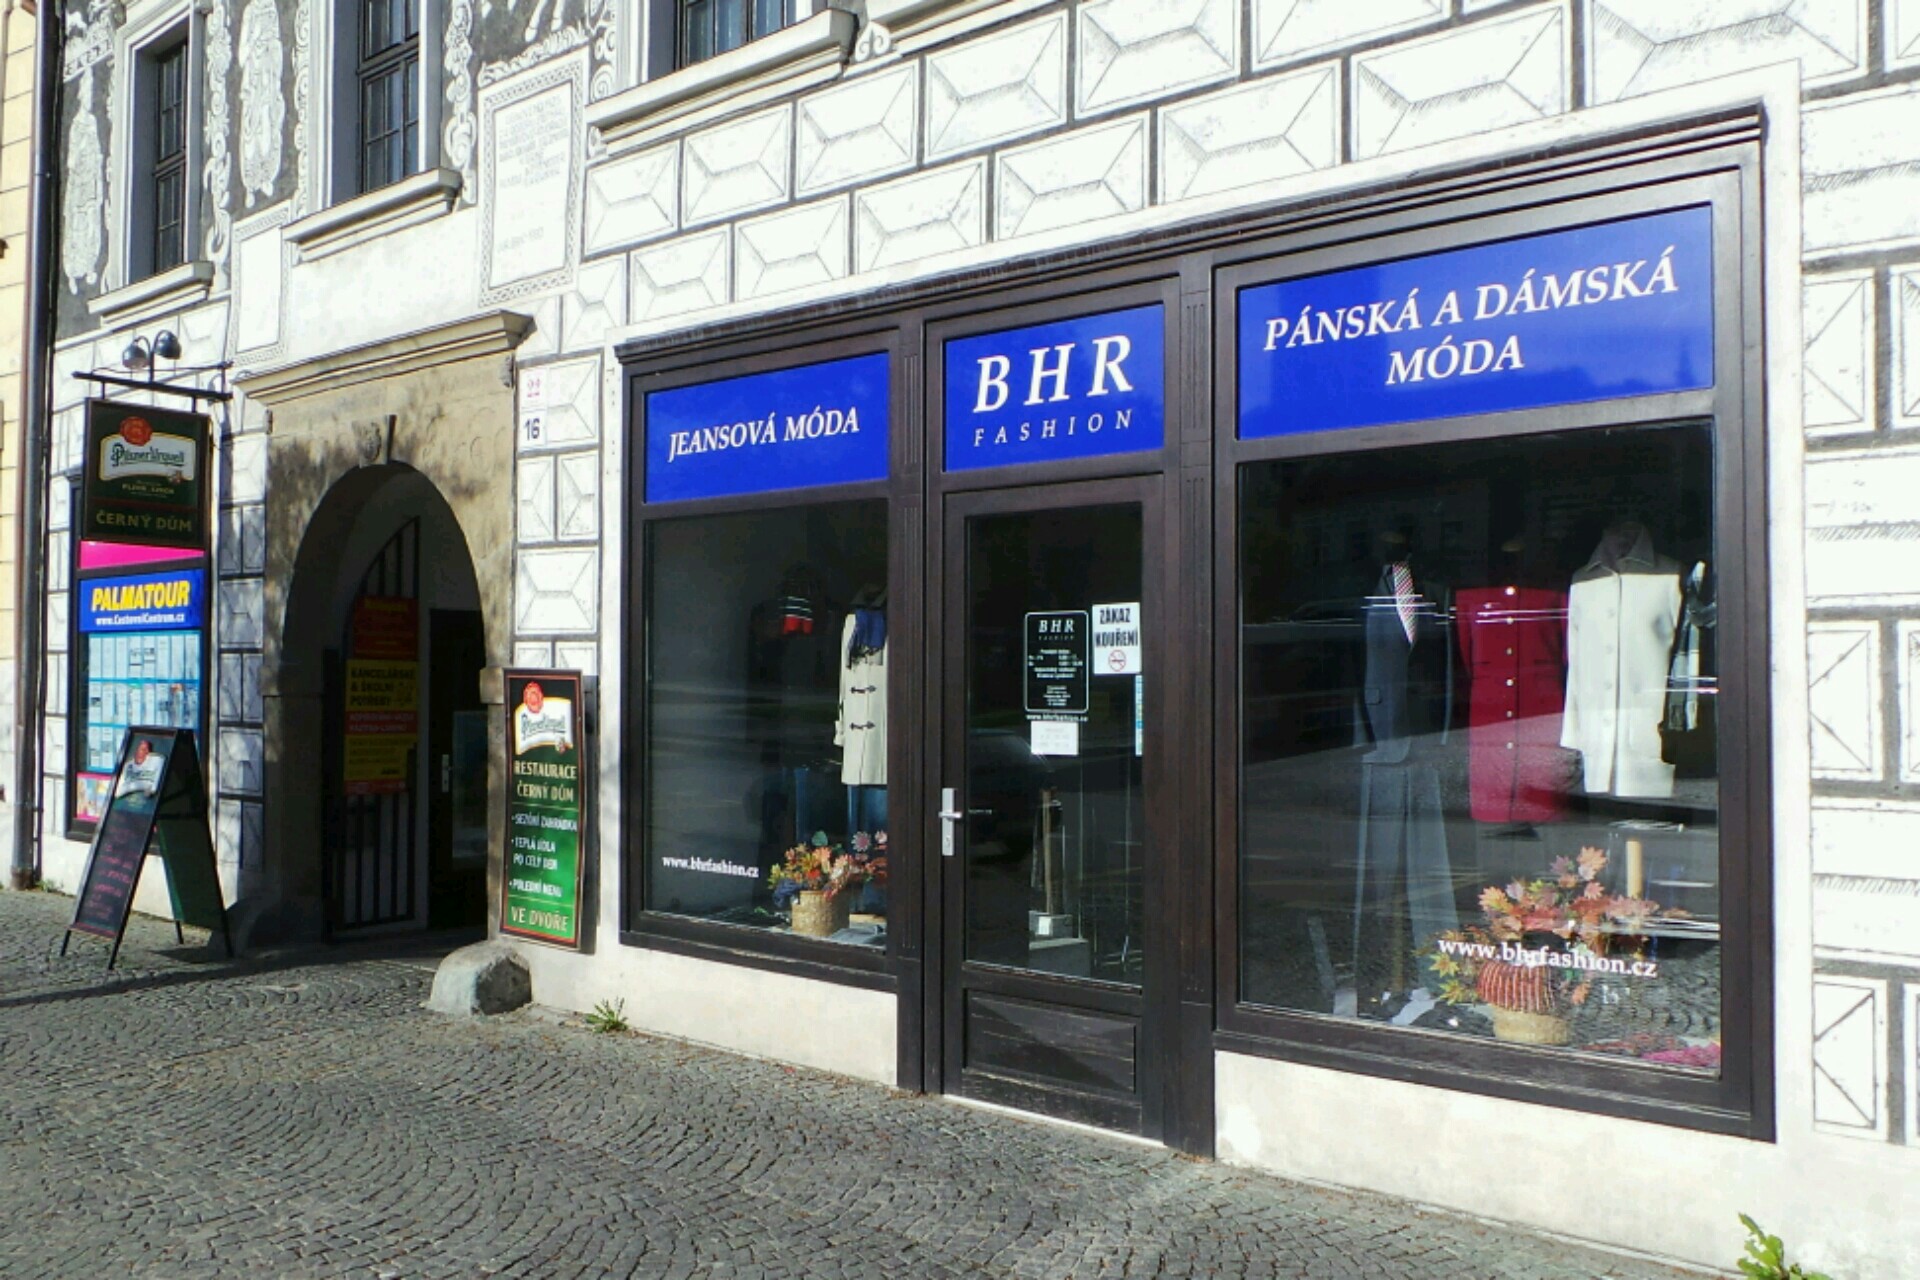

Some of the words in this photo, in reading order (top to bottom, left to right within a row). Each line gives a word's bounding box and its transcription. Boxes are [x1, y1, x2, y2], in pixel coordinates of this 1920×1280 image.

[1263, 287, 1422, 352] PÁNSKÁ
[1431, 291, 1463, 327] A
[1474, 244, 1679, 321] DÁMSKÁ
[1385, 333, 1525, 386] MÓDA
[523, 416, 541, 441] 16
[668, 411, 778, 463] JEANSOVÁ
[783, 404, 861, 442] MÓDA
[972, 408, 1134, 448] FASHION
[111, 442, 149, 467] Pilsner
[95, 509, 152, 529] ČERNÝ
[155, 515, 192, 532] DŮM
[91, 580, 191, 613] PALMATOUR
[1099, 607, 1131, 625] ZÁKAZ
[1094, 628, 1139, 648] KOUŘENÍ
[513, 760, 578, 780] RESTAURACE
[516, 780, 549, 800] ČERNÝ
[550, 785, 575, 802] DŮM
[514, 835, 536, 851] TEPLÁ
[513, 853, 524, 865] PO
[524, 853, 542, 868] CELÝ
[542, 859, 558, 871] DEN
[661, 855, 760, 878] www.bhrfashion.cz
[512, 878, 542, 894] POLEDNÍ
[511, 906, 527, 924] VE
[529, 909, 570, 932] DVOŘE
[1437, 938, 1659, 978] www.bhrfashion.cz
